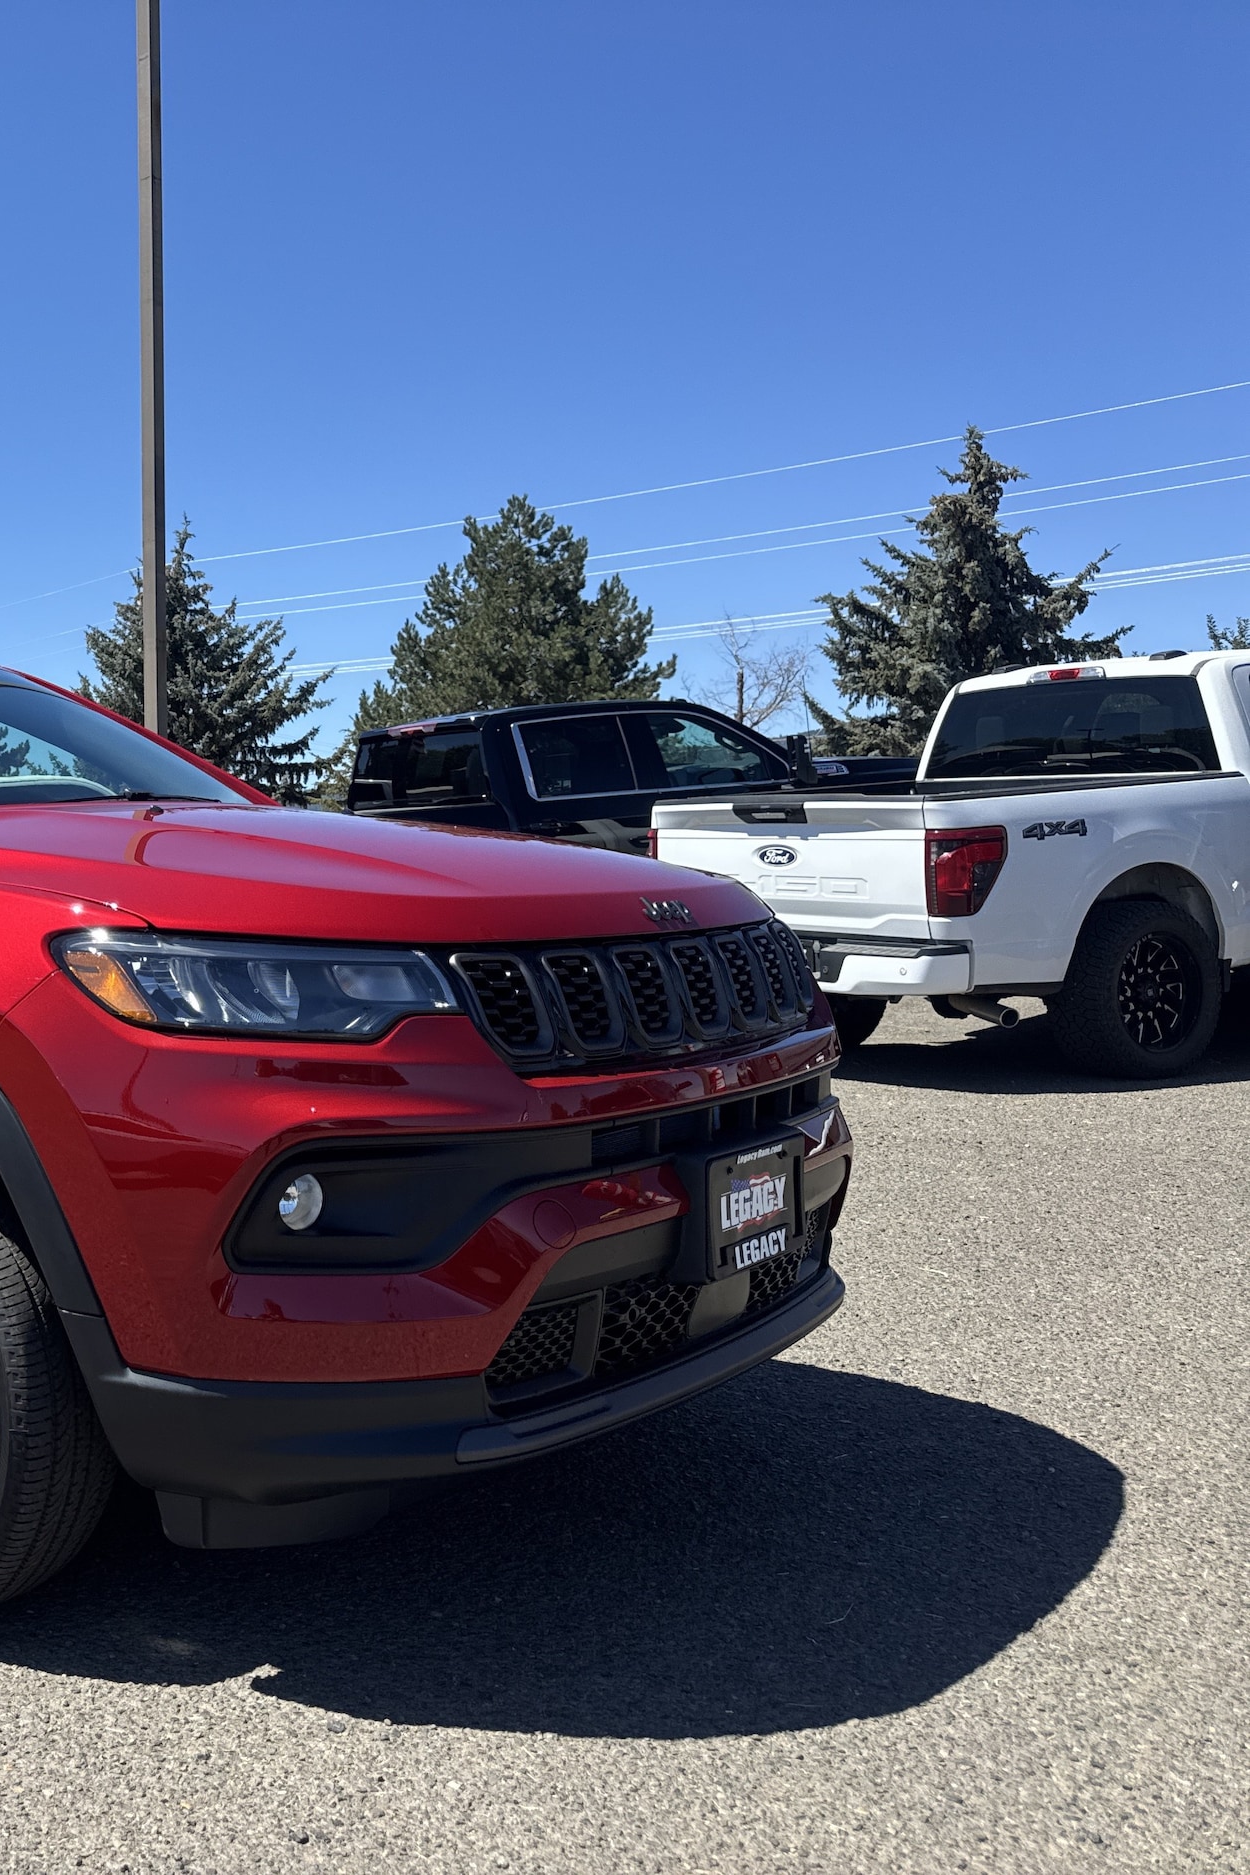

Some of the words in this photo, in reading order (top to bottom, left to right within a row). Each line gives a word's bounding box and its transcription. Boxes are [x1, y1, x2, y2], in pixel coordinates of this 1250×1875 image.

[763, 849, 789, 864] Ford
[639, 896, 692, 923] Jeep
[721, 1176, 786, 1229] LEGACY
[735, 1228, 786, 1270] LEGACY
